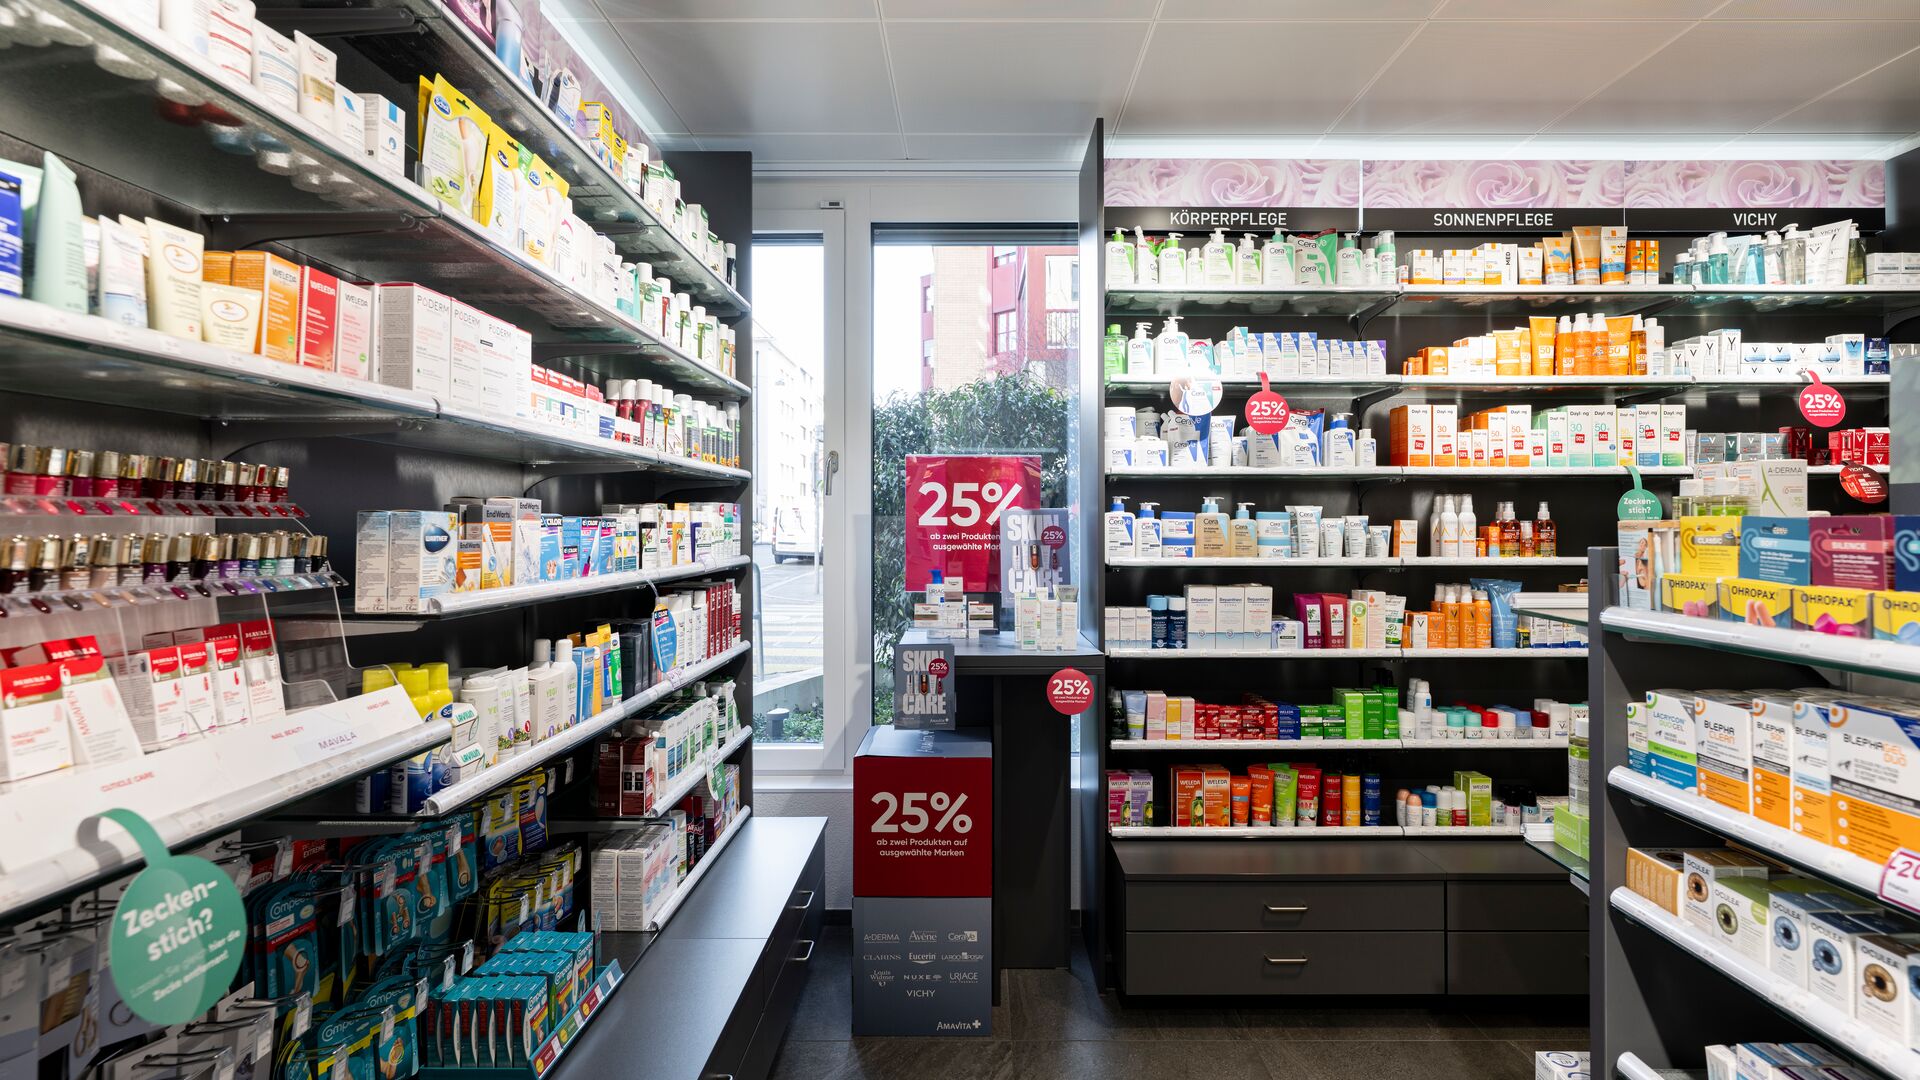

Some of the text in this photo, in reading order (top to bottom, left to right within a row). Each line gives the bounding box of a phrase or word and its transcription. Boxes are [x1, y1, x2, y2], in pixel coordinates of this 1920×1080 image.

[1170, 209, 1287, 226] KÖRPERPFLEGE
[1433, 213, 1553, 227] SONNENPFLEGE
[1733, 213, 1777, 227] VICHY
[310, 280, 336, 297] WELEDA
[1250, 401, 1286, 416] 25%
[1804, 393, 1841, 409] 25%
[1412, 425, 1422, 433] 25
[1437, 425, 1447, 433] 30
[1570, 423, 1582, 432] 30
[918, 482, 1024, 527] 25%
[1624, 497, 1655, 505] Zecken-
[486, 510, 511, 518] EndWarts
[1043, 531, 1064, 540] 25%
[933, 544, 982, 552] ausgewählte
[1008, 566, 1064, 594] CARE
[1669, 579, 1706, 592] OHROPAX
[1731, 585, 1776, 600] OHROPAX
[1801, 592, 1853, 608] OHROPAX
[902, 650, 944, 672] SKIN
[930, 662, 948, 671] 25%
[1052, 679, 1090, 695] 25%
[902, 693, 946, 715] CARE
[1704, 720, 1735, 736] BLEPHA
[1757, 721, 1785, 735] BLEPHA
[1795, 726, 1827, 741] BLEPHA
[318, 730, 358, 750] MAVALA
[871, 792, 973, 834] 25%
[876, 838, 968, 846] ab zwei Produkten auf
[880, 849, 932, 858] ausgewählte
[1686, 858, 1710, 877] OCULEA
[1714, 888, 1741, 907] OCULEA
[122, 880, 218, 938] Zecken-
[1772, 900, 1801, 923] OCULEA
[147, 908, 214, 962] stich?
[948, 931, 978, 942] CeraVe
[1810, 921, 1844, 945] OCULEA
[909, 952, 936, 960] Eucerin
[1861, 945, 1900, 970] OCULEA
[949, 972, 978, 981] URIAGE
[906, 989, 936, 998] VICHY
